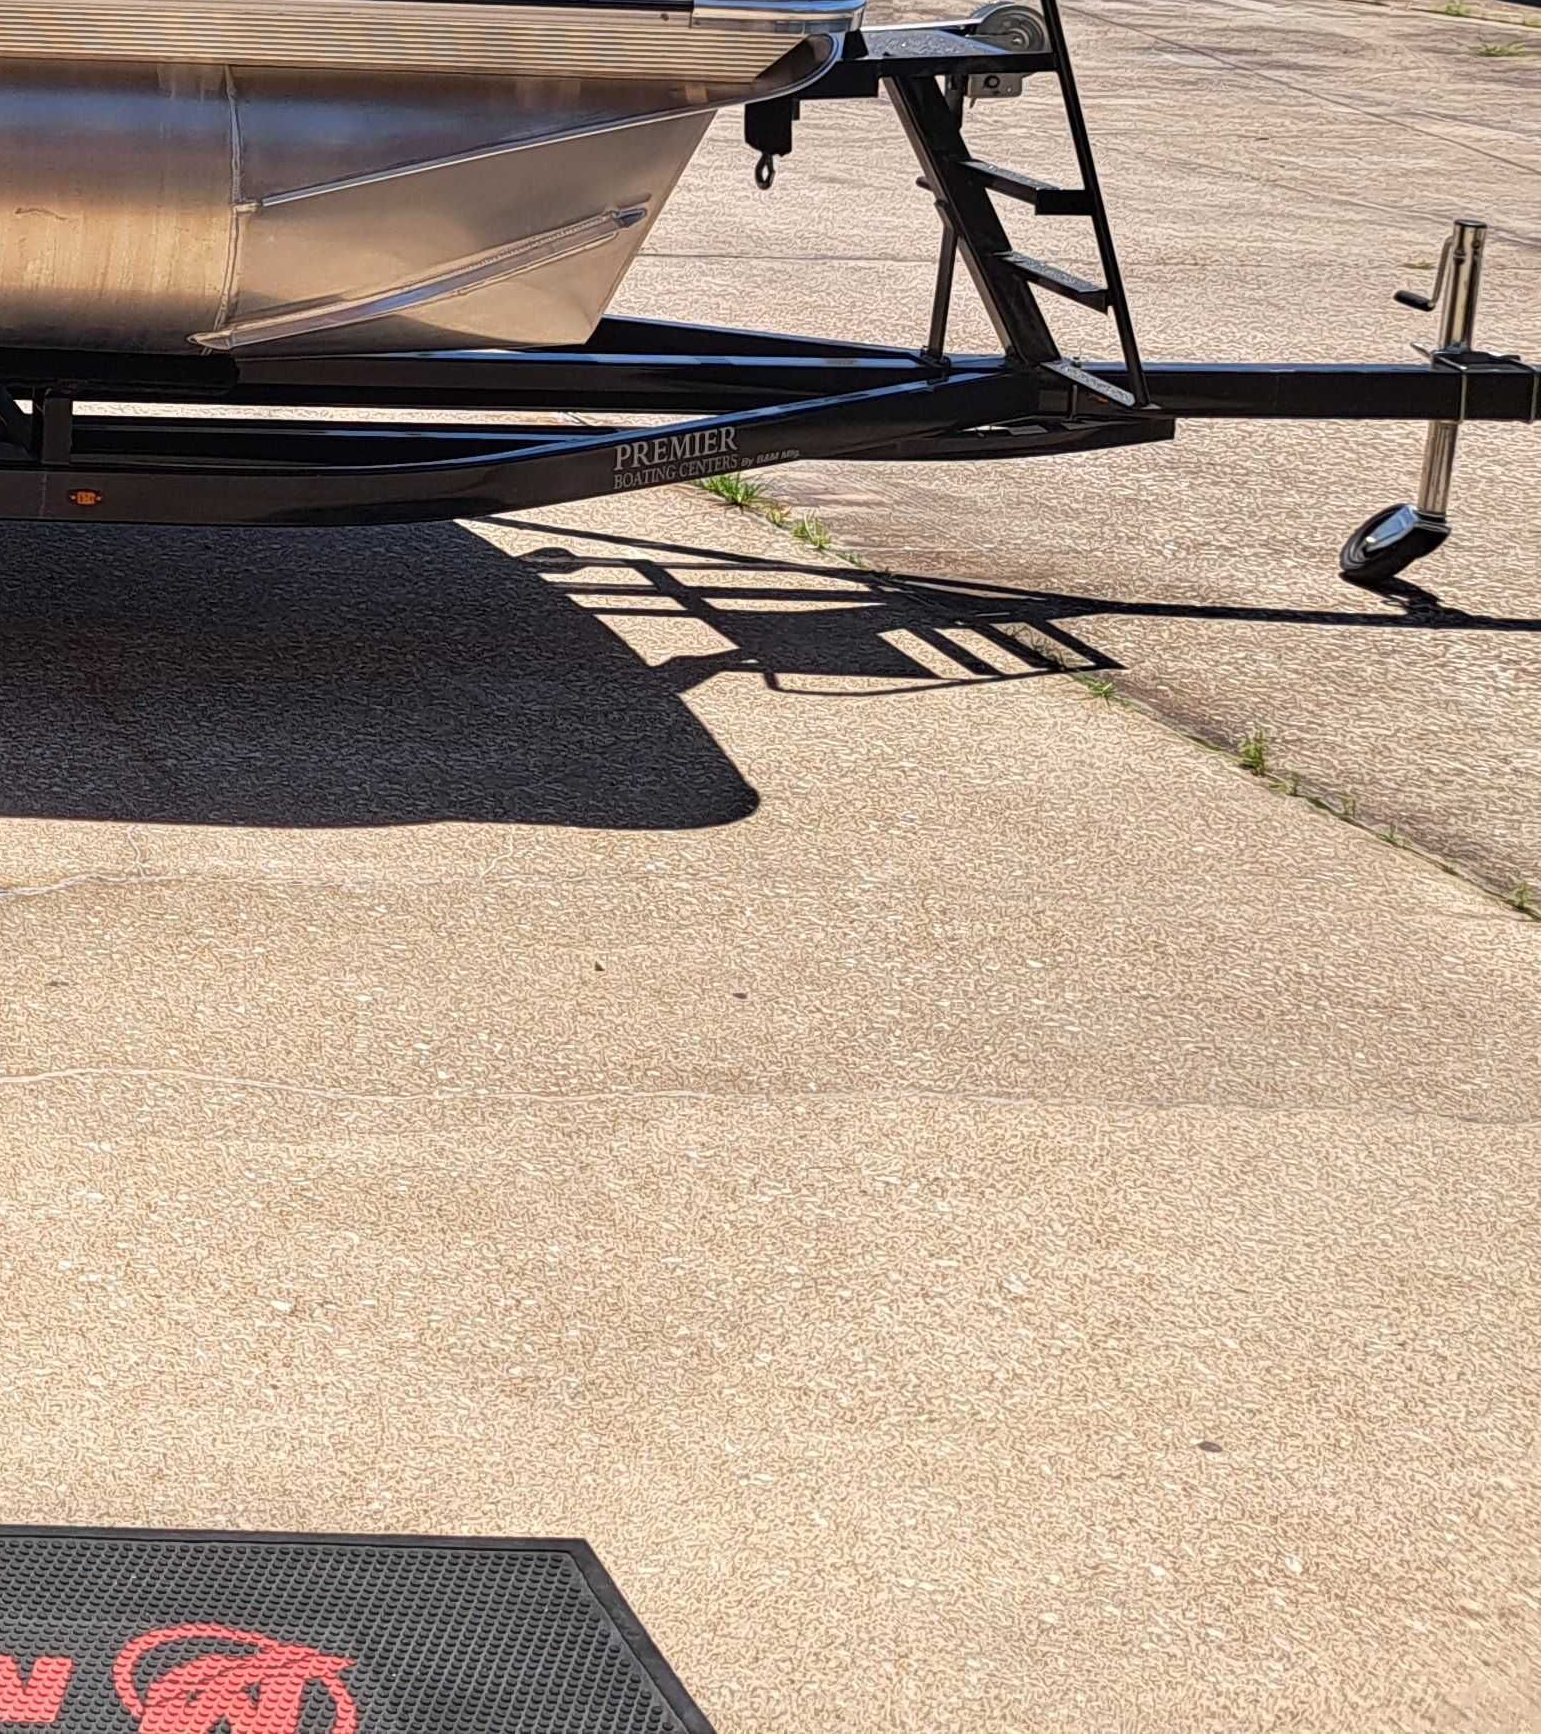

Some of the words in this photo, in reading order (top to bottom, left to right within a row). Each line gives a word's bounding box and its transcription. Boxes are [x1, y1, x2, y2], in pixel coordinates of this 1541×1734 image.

[613, 426, 738, 471] PREMIER
[613, 465, 677, 490] BOATING
[679, 453, 738, 478] CENTERS
